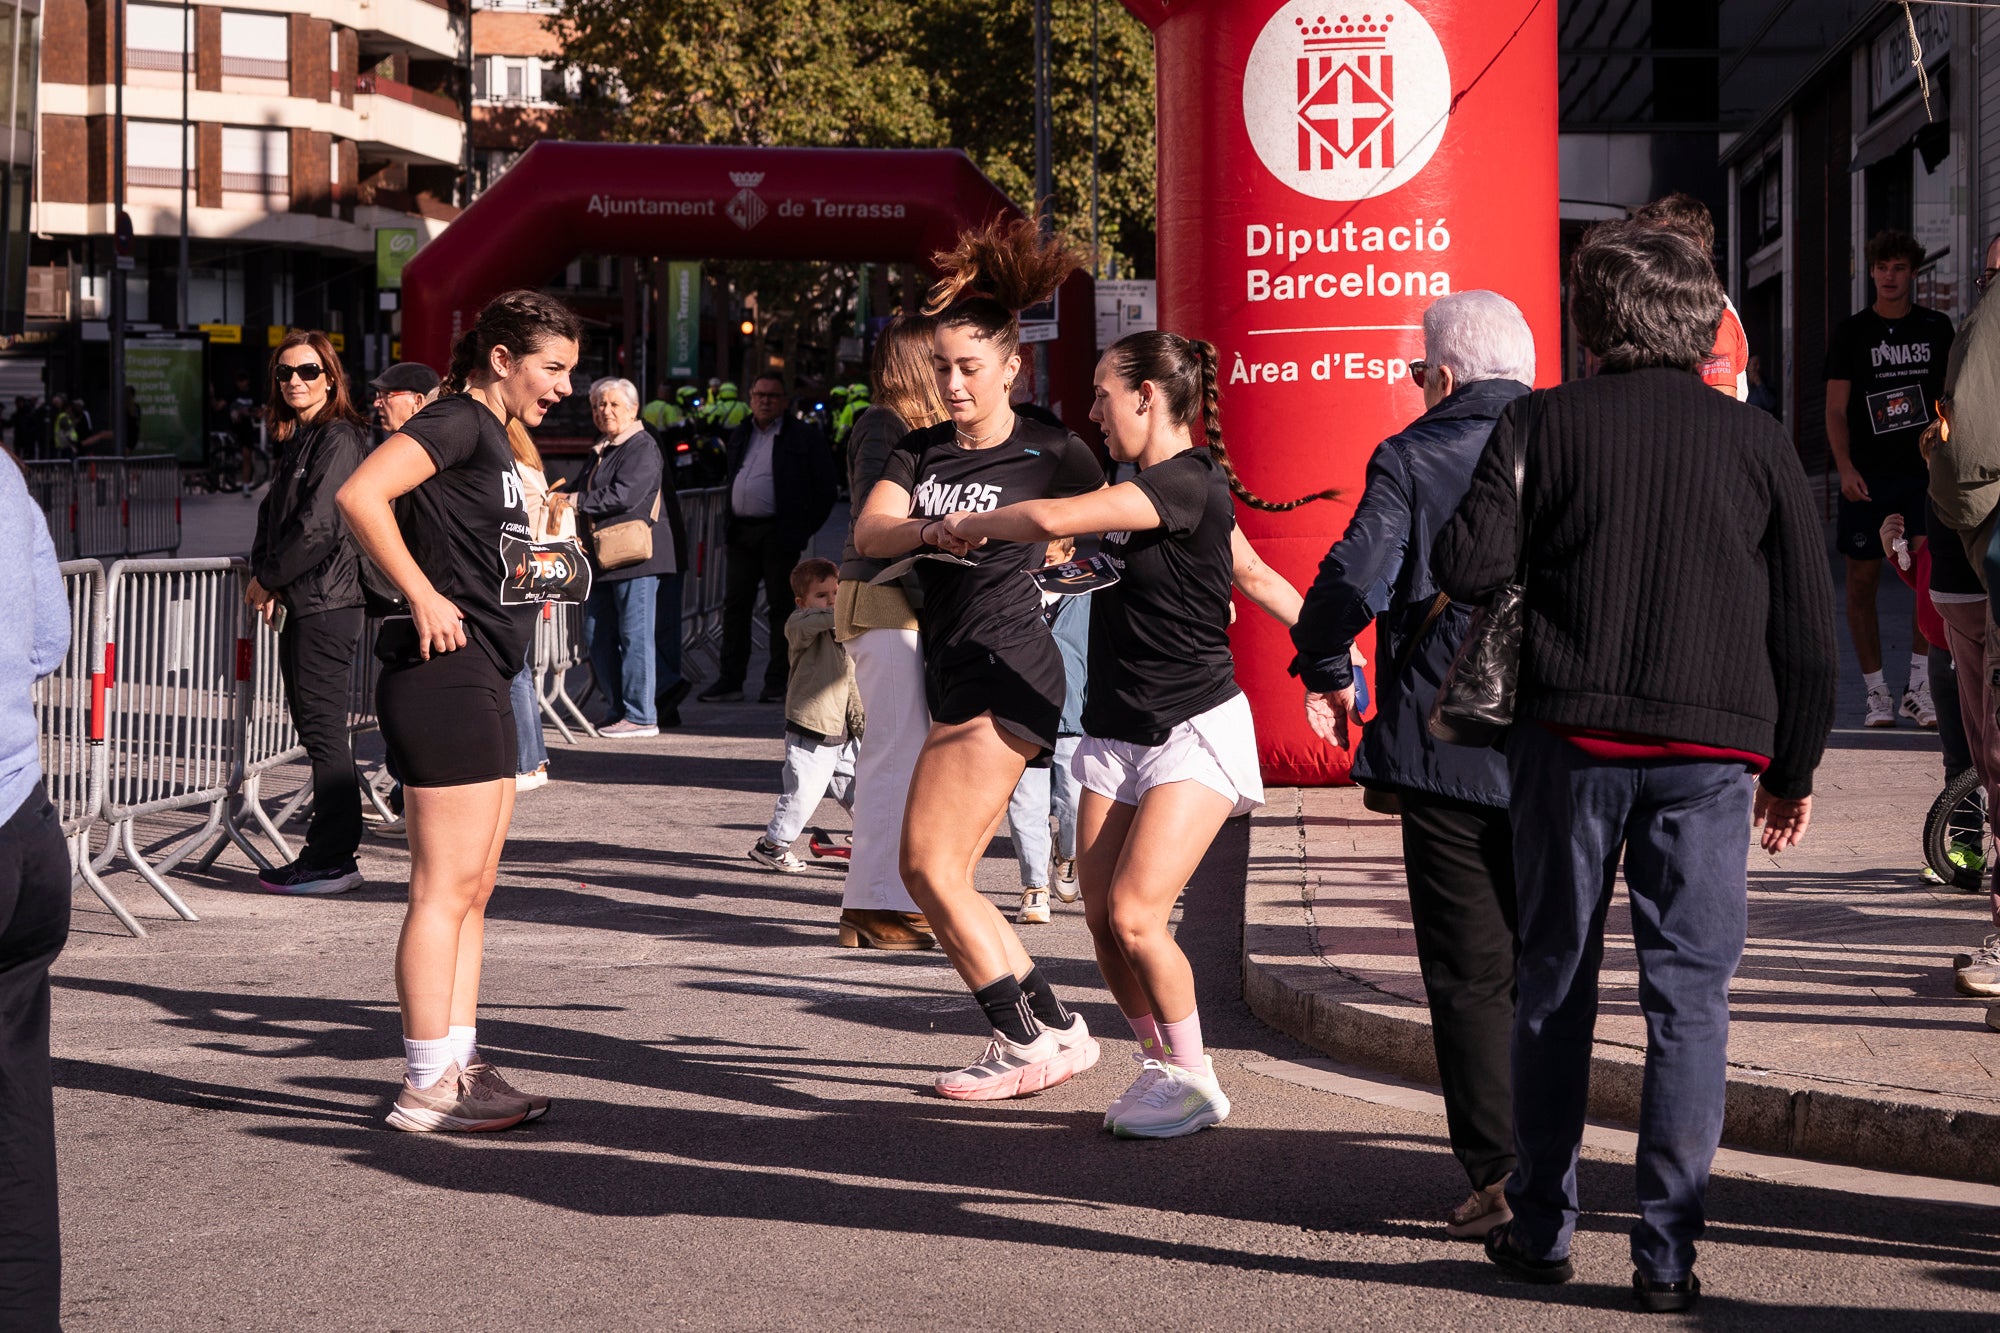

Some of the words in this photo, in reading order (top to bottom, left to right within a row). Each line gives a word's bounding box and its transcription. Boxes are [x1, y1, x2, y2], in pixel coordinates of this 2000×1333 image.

[587, 194, 715, 218] Ajuntament
[777, 200, 804, 217] de
[812, 199, 906, 218] Terrassa
[1246, 218, 1451, 262] Diputació
[1247, 265, 1451, 302] Barcelona
[1229, 352, 1299, 385] Àrea
[1887, 402, 1910, 417] 569
[506, 522, 526, 535] CURSA
[530, 560, 568, 579] 758
